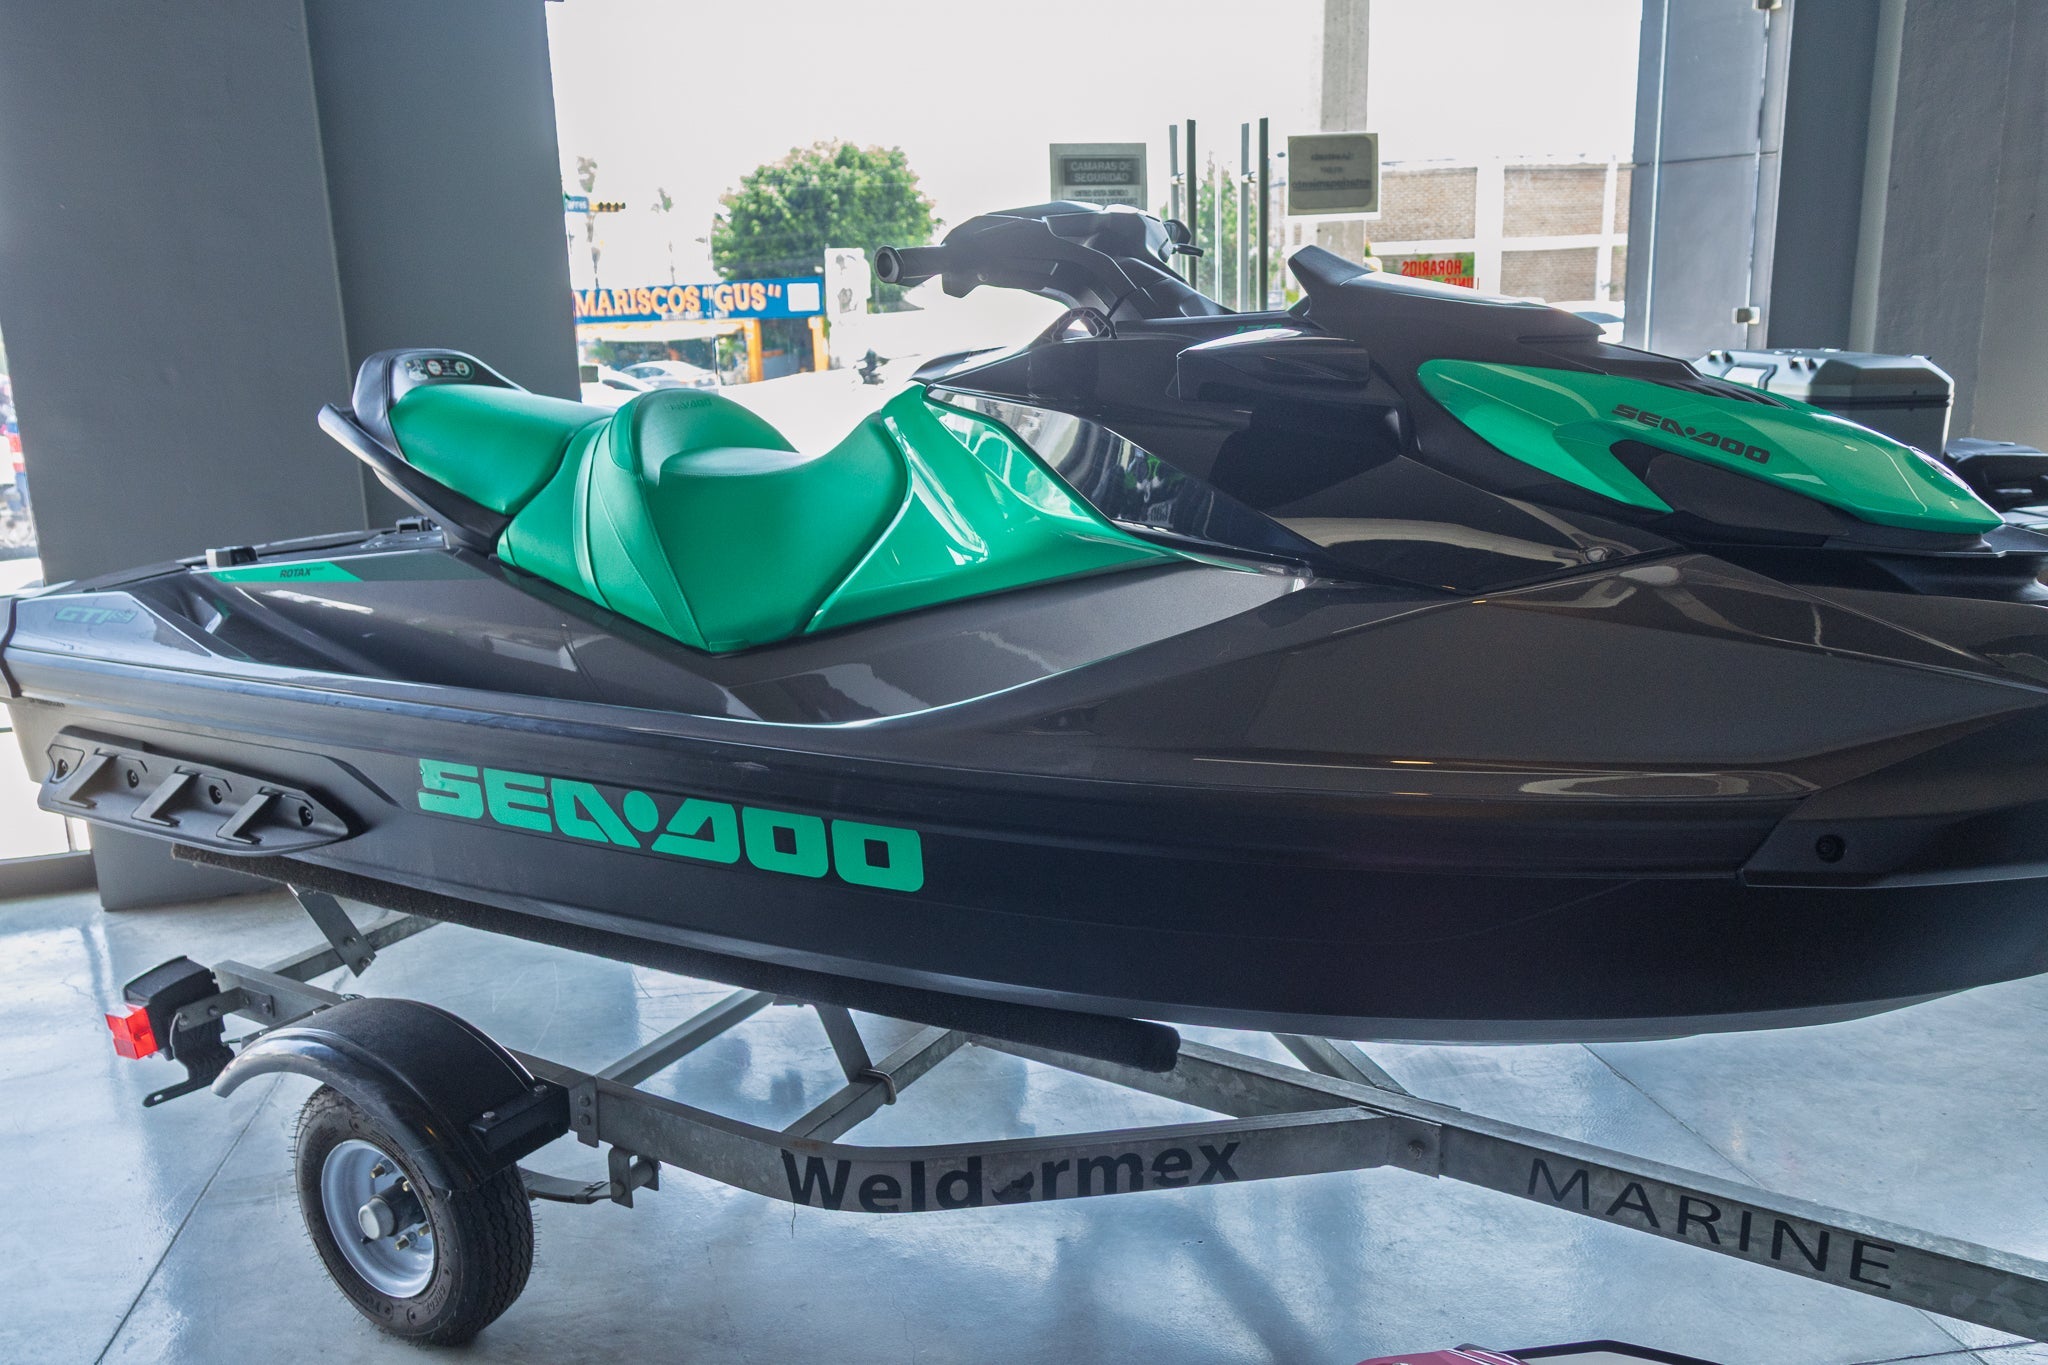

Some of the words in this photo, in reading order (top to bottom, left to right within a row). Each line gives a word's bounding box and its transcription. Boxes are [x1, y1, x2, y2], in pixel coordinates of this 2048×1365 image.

[1071, 161, 1117, 171] CAMARAS
[1074, 172, 1129, 182] SEGURIDAD
[574, 285, 701, 317] MARISCOS
[703, 282, 782, 311] "GUS"
[280, 568, 311, 578] ROTAX
[55, 605, 112, 625] GTI
[1527, 1158, 1896, 1290] MARINE
